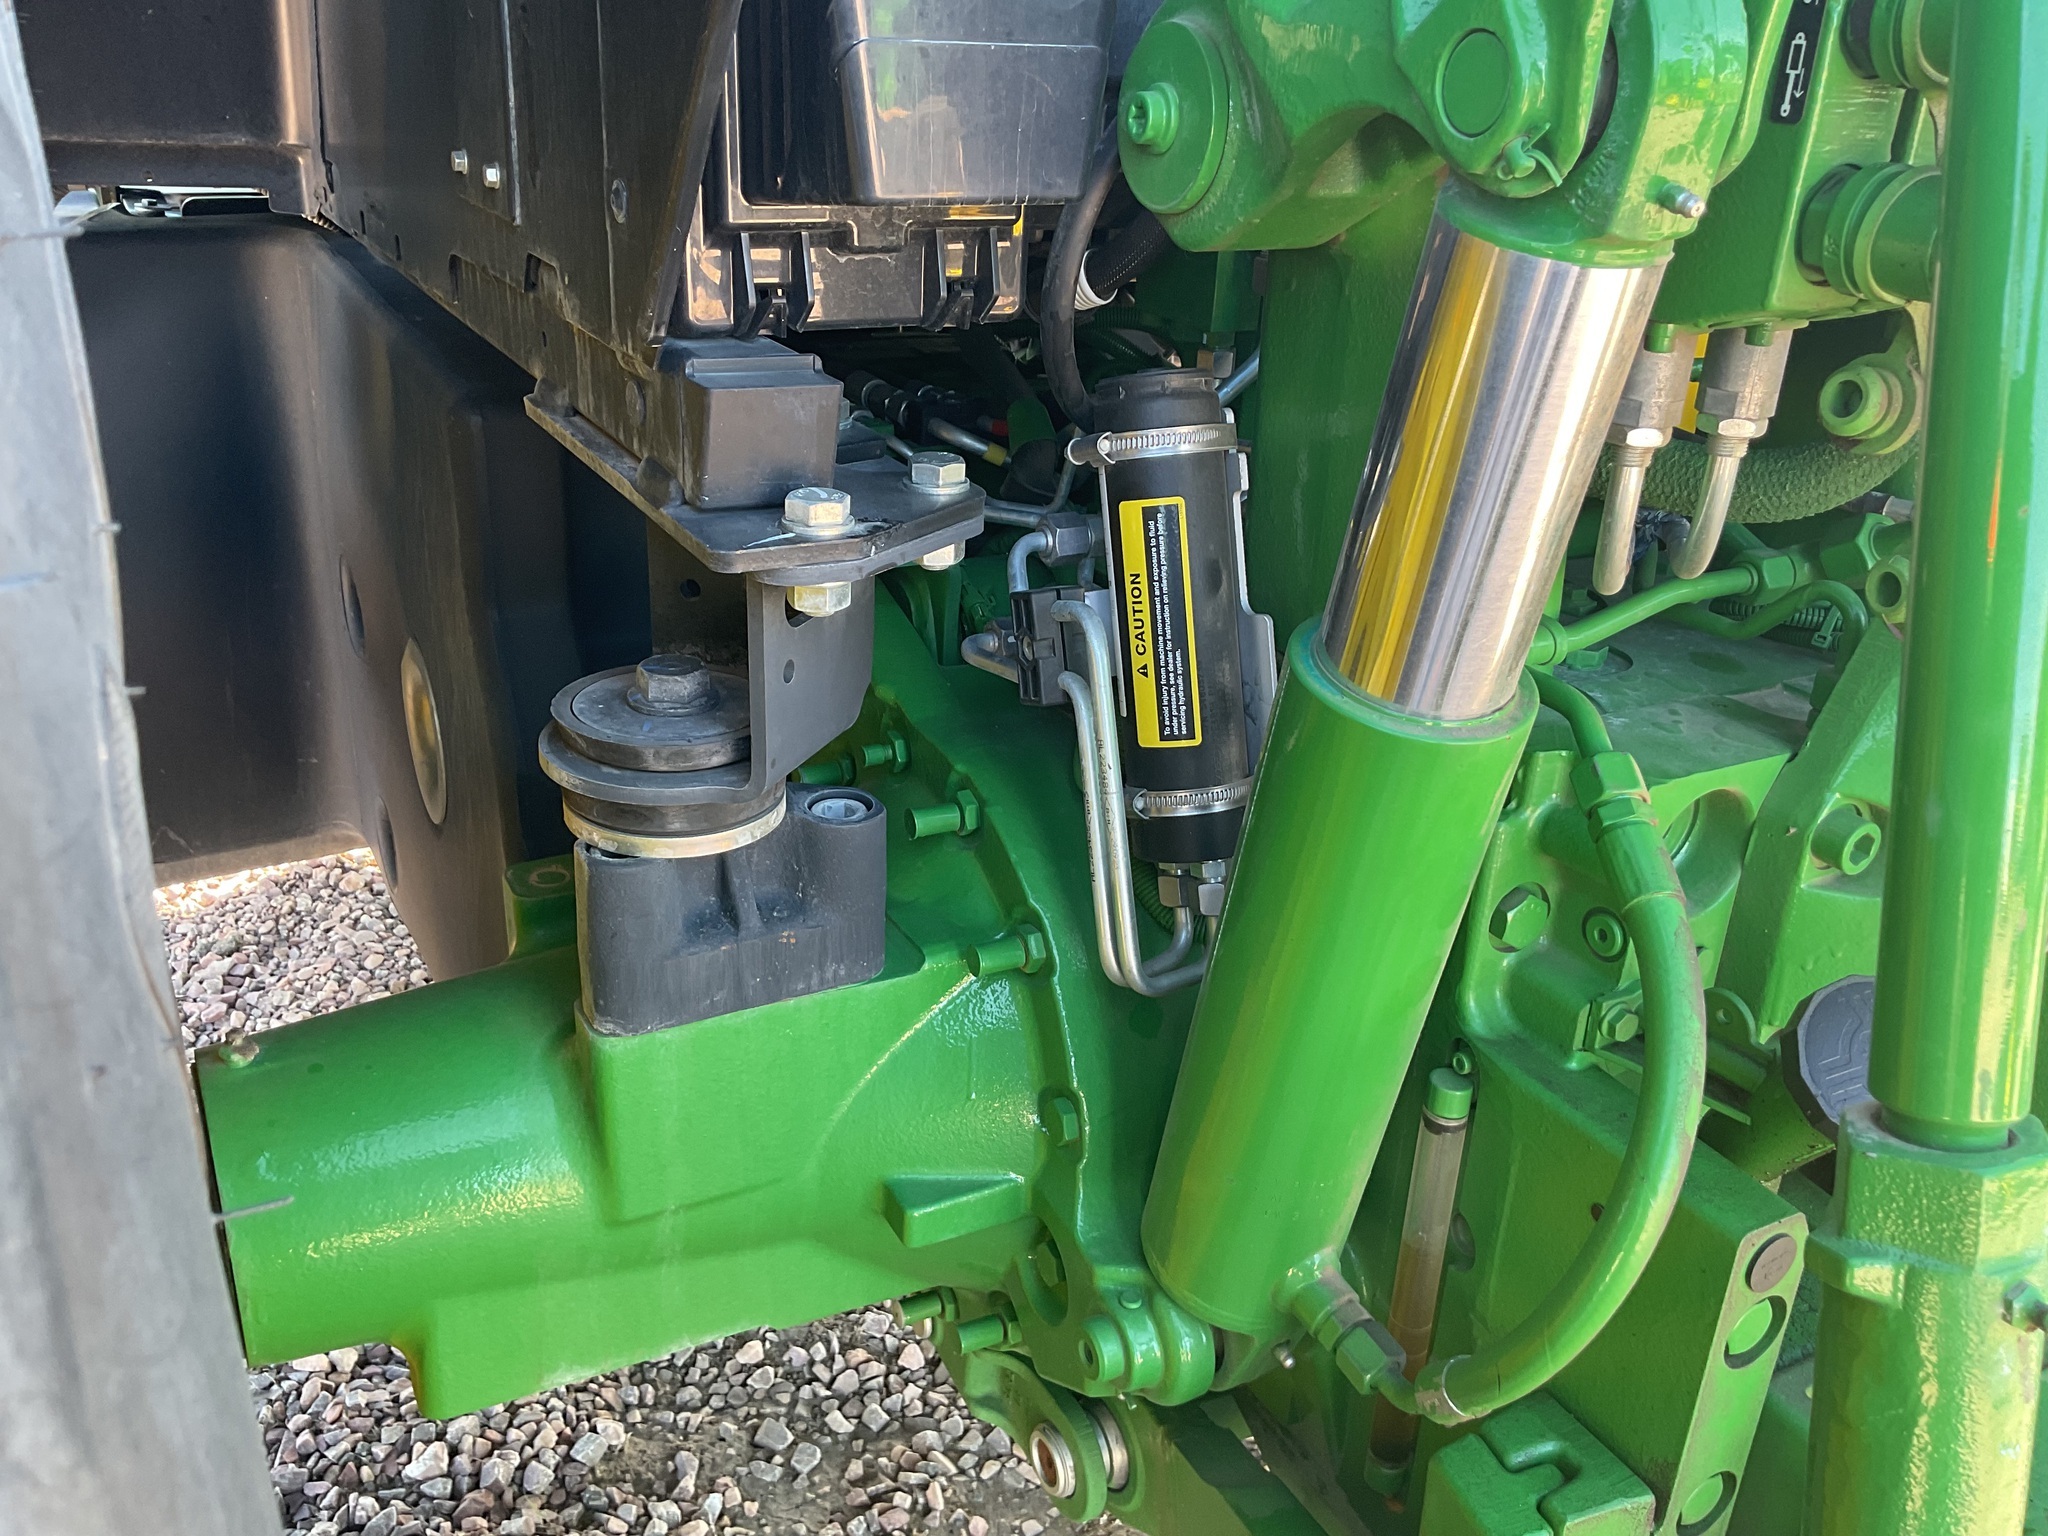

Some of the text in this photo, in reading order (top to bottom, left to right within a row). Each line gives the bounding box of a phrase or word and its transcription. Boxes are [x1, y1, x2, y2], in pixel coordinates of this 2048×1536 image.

[1150, 538, 1155, 546] to
[1158, 536, 1166, 564] pressure
[1150, 547, 1159, 580] exposure
[1160, 566, 1168, 593] relieving
[1163, 595, 1168, 603] on
[1130, 573, 1146, 656] CAUTION
[1154, 597, 1163, 634] movement
[1163, 605, 1171, 639] instruction
[1175, 649, 1183, 674] system.
[1170, 685, 1178, 715] pressure,
[1164, 727, 1170, 735] To
